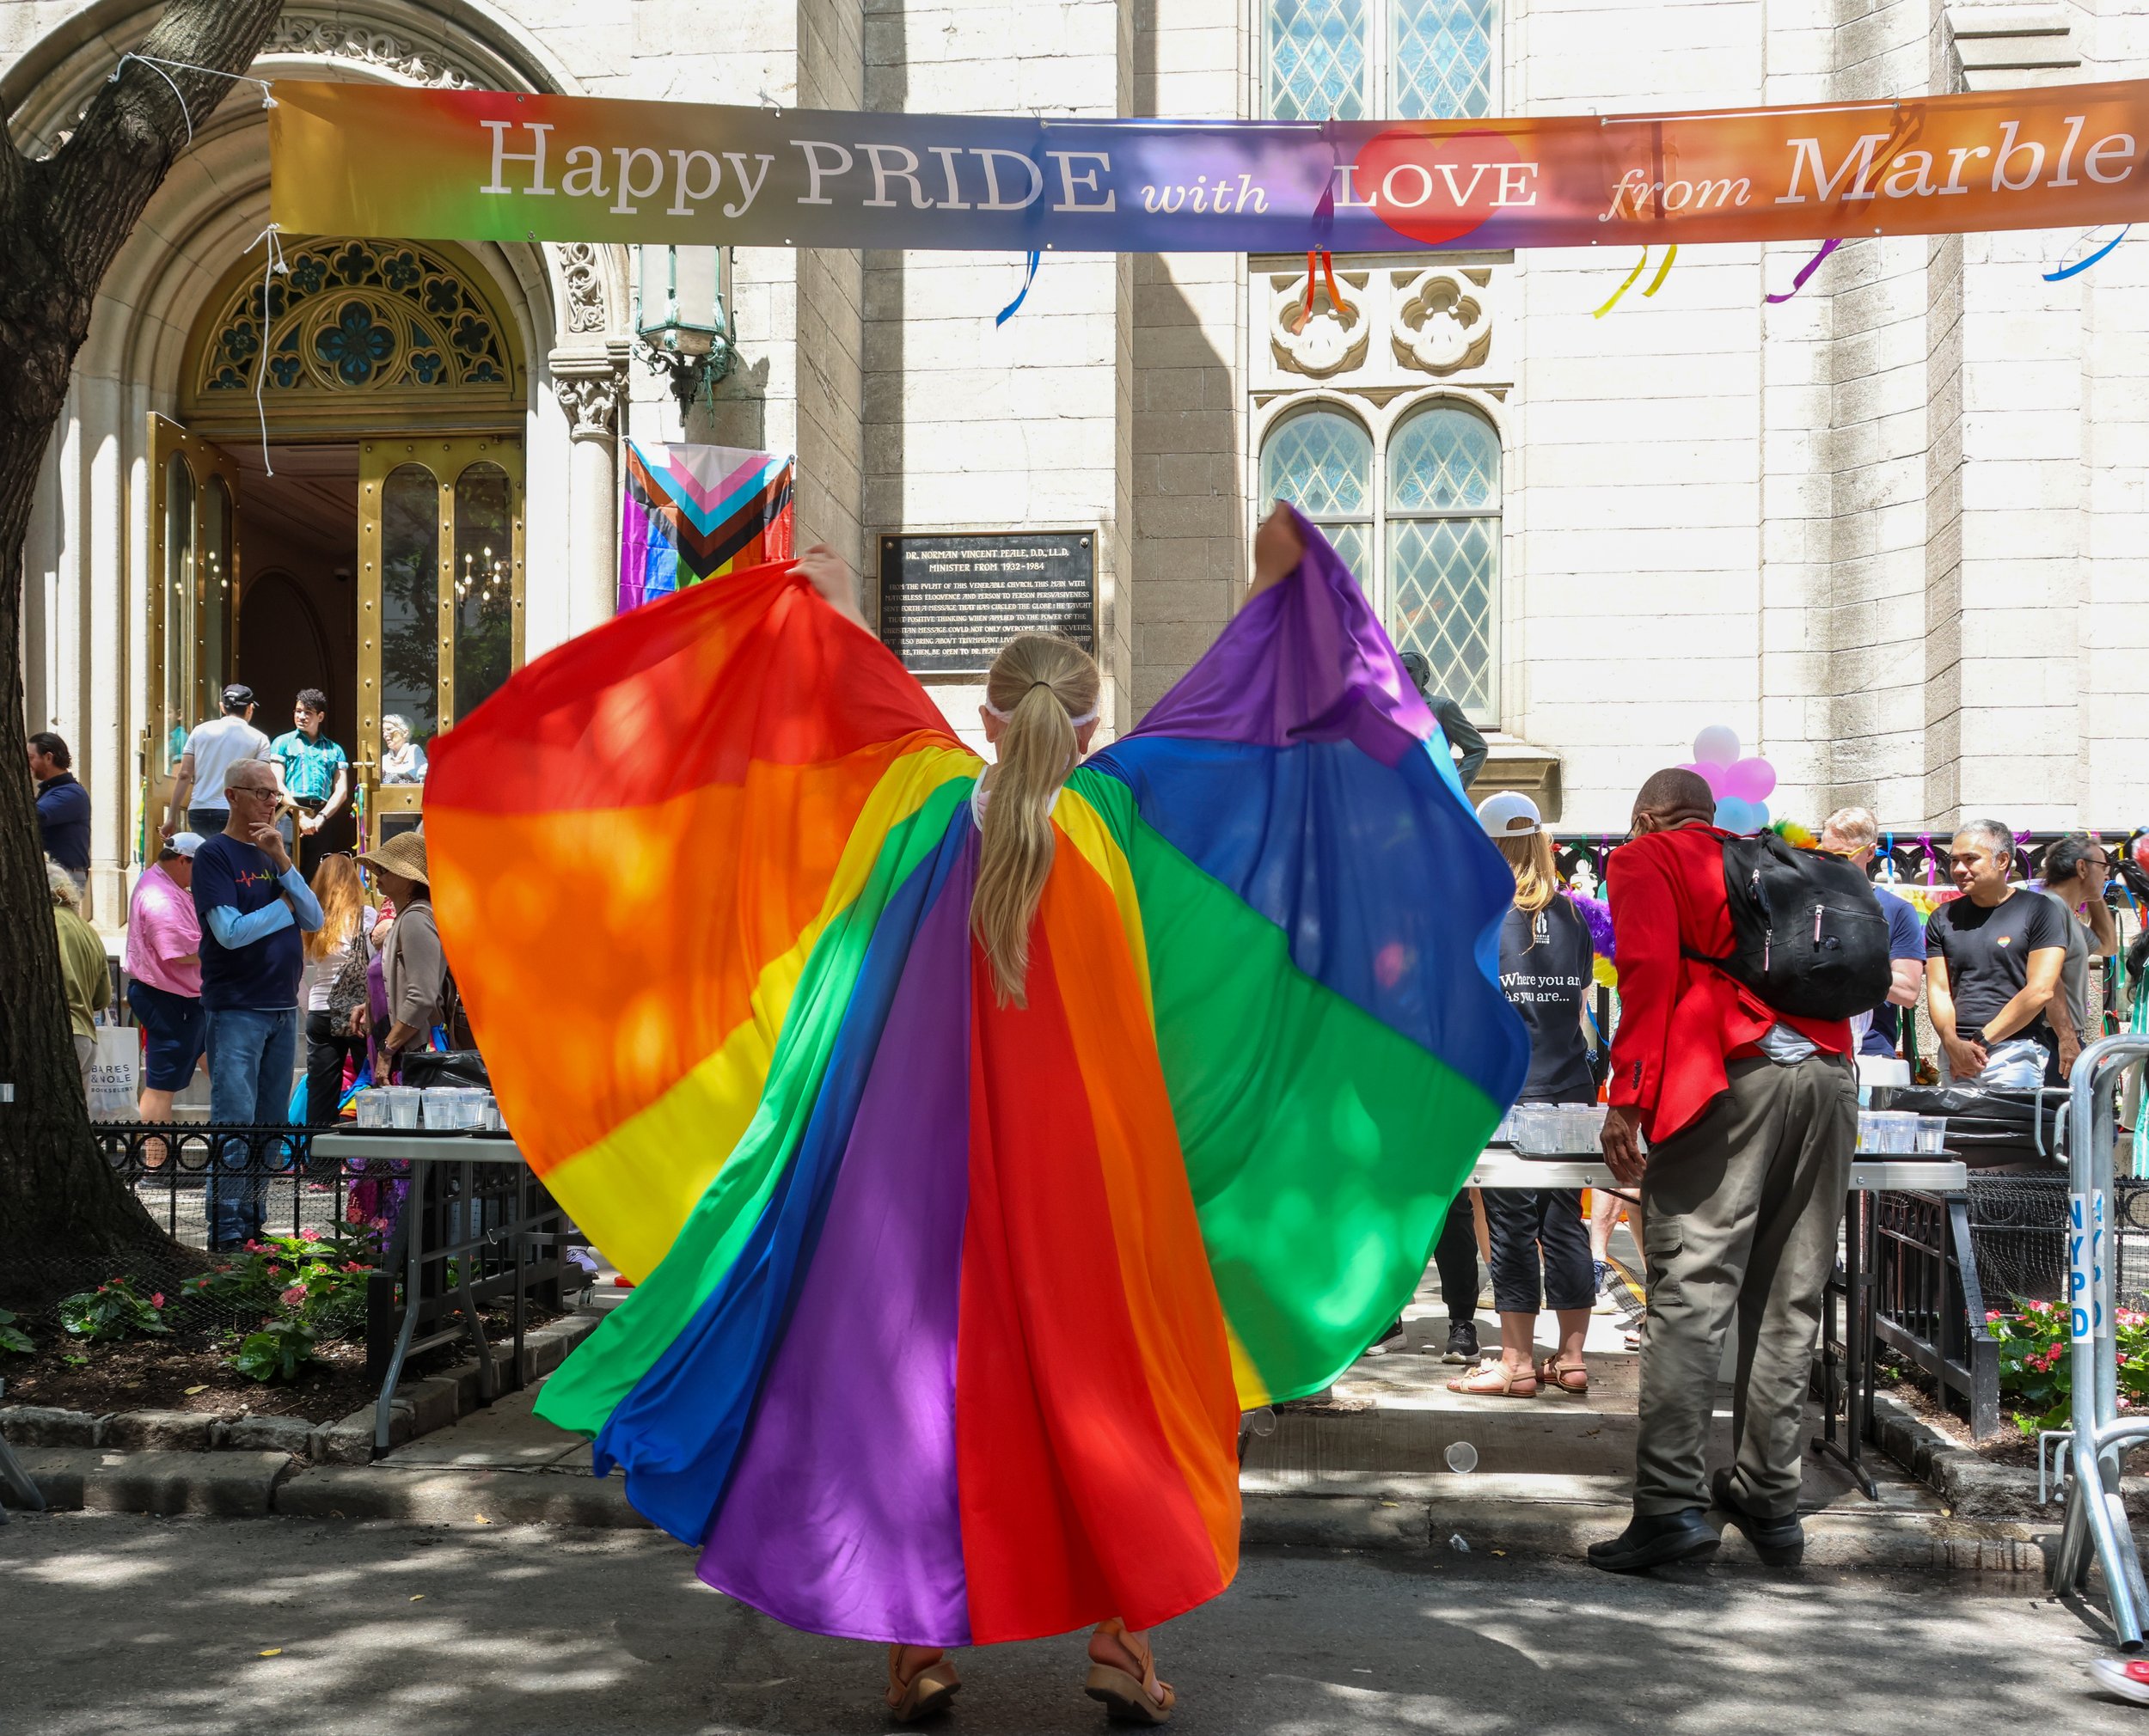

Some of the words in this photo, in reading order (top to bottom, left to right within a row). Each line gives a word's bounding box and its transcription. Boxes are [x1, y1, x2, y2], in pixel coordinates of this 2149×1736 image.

[479, 119, 775, 218] Happy
[788, 139, 1116, 213] PRIDE
[1140, 174, 1270, 215] with
[1332, 162, 1539, 208] LOVE
[1597, 168, 1751, 223] from
[1773, 115, 2136, 205] Marble
[905, 551, 920, 559] DR.
[921, 550, 958, 559] NORMAN
[960, 549, 998, 559] VINCENT
[1001, 548, 1029, 558] PEALE,
[928, 563, 970, 572] MINISTER
[974, 563, 998, 572] FROM
[1001, 562, 1045, 571] 1932-1984
[1498, 971, 1536, 987] Where
[1538, 976, 1564, 988] you
[1567, 976, 1581, 986] ar
[1504, 990, 1520, 1002] As
[1536, 992, 1570, 1002] are...
[91, 1064, 130, 1073] BARES
[91, 1074, 98, 1084] &
[2070, 1200, 2089, 1338] NYPD
